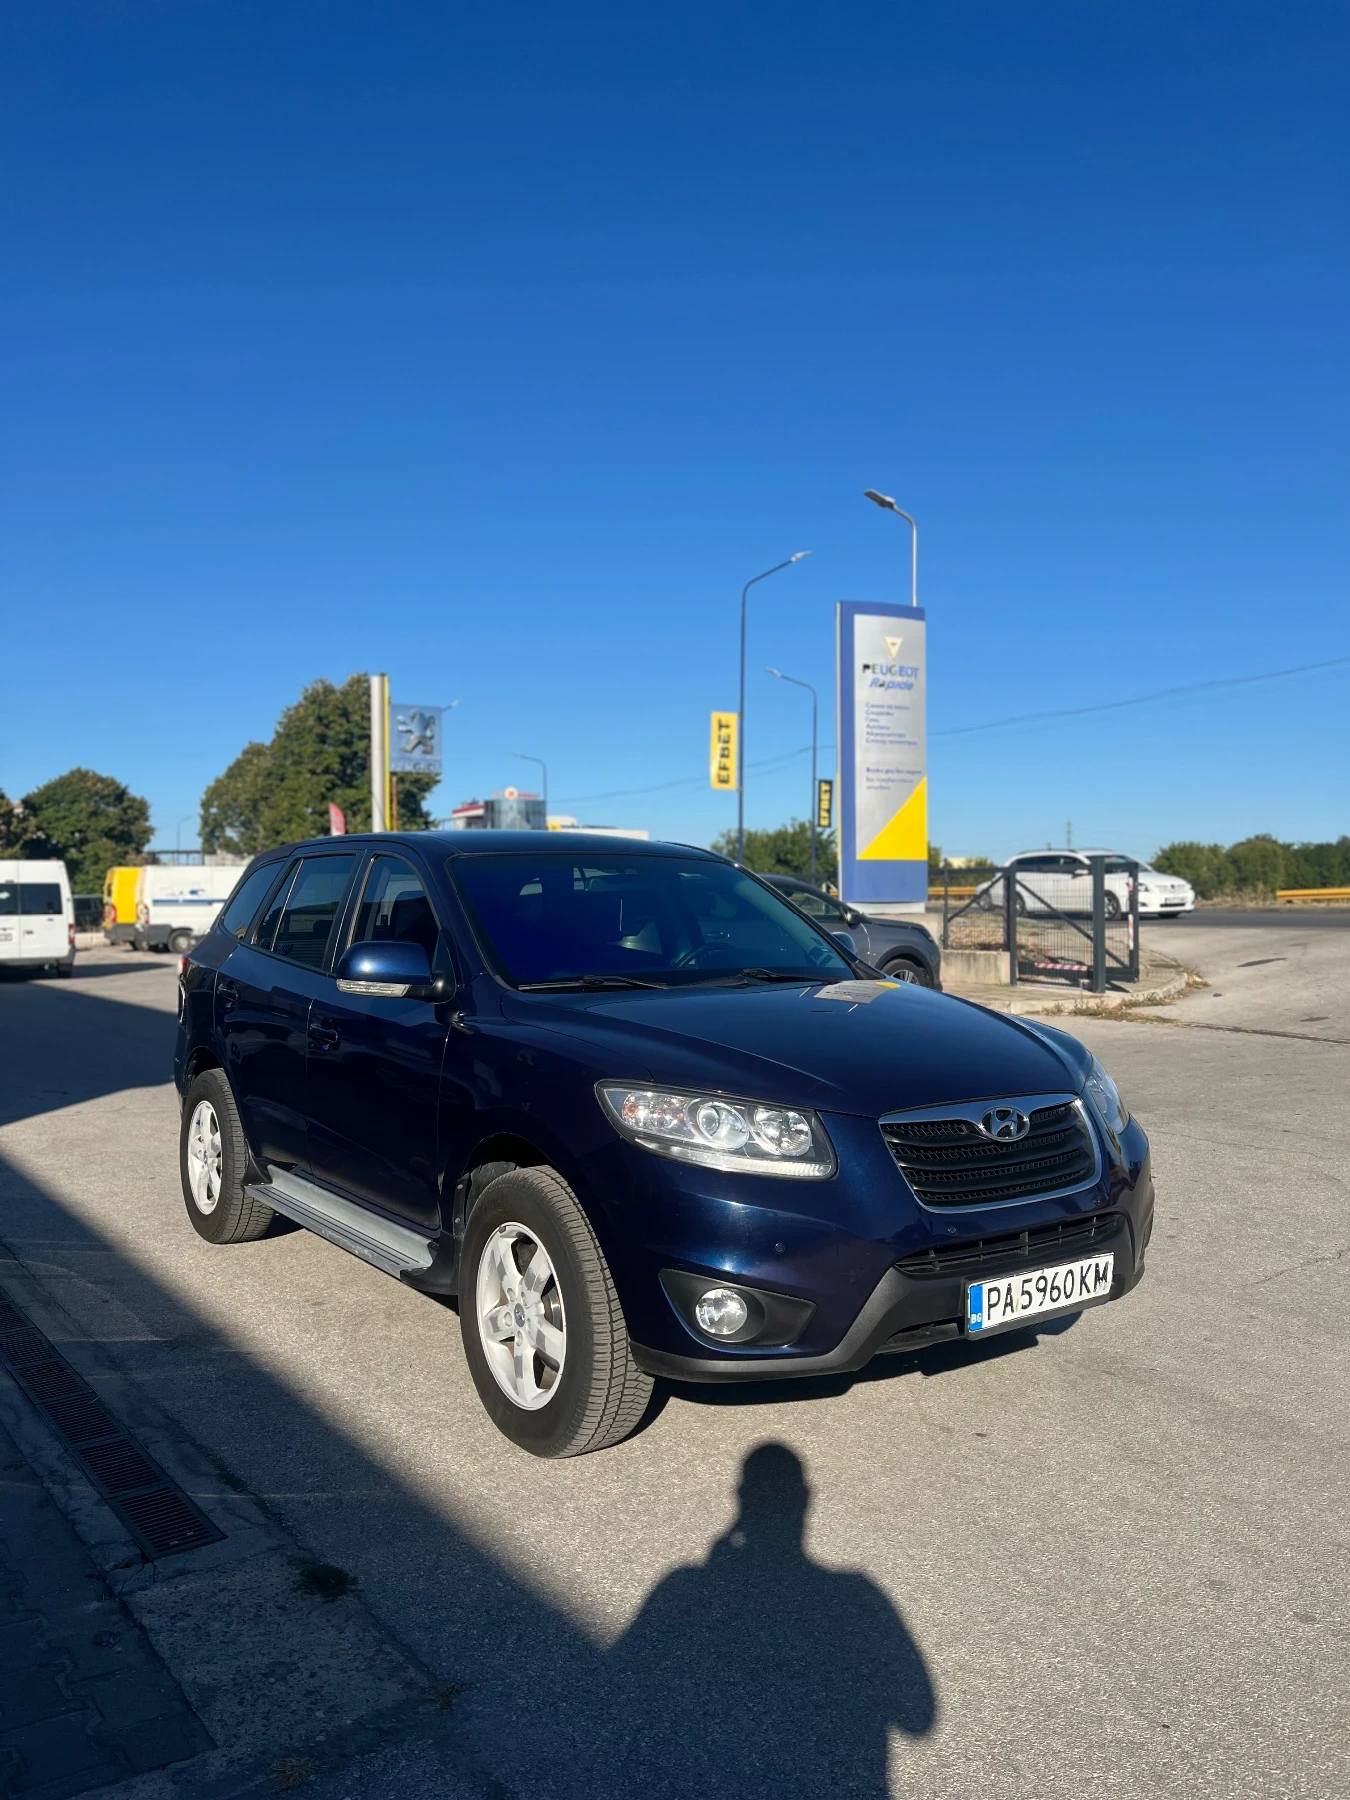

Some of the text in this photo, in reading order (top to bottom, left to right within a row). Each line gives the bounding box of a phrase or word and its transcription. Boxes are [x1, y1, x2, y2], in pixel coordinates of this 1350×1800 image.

[862, 664, 920, 678] PEUGEOT
[718, 719, 731, 785] EFBET
[971, 1312, 982, 1324] BG
